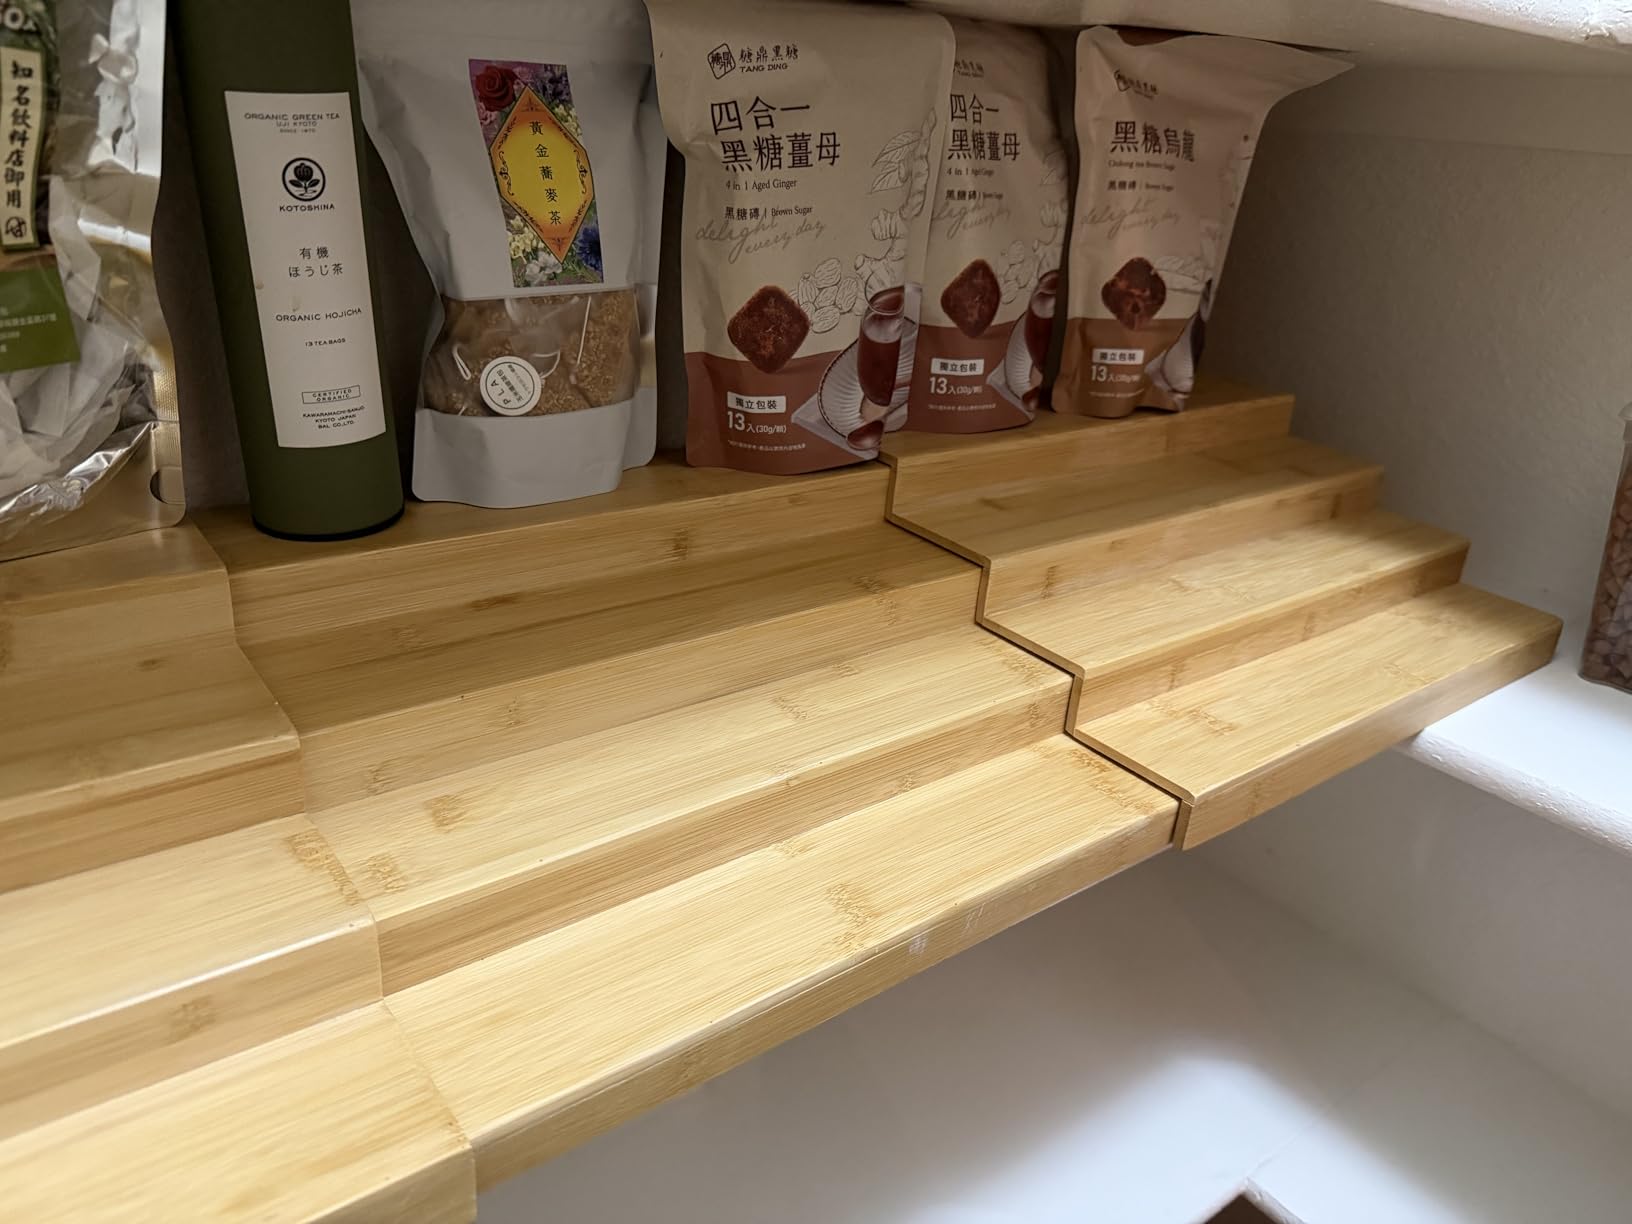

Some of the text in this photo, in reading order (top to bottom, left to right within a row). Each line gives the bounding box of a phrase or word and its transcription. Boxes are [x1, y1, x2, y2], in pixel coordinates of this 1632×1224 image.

[739, 62, 788, 73] TANG DING
[950, 93, 999, 124] 四合一
[244, 112, 340, 121] ORGANIC GREEN TEA
[710, 96, 810, 135] 四合一
[947, 129, 1021, 161] 黑糖薑母
[1109, 120, 1196, 162] 黑糖烏龍
[720, 131, 841, 173] 黑糖薑母
[529, 120, 562, 225] 黃金蕎麥茶
[725, 181, 731, 190] 4
[732, 181, 741, 191] in
[752, 180, 771, 192] Aged
[772, 178, 798, 190] Ginger
[279, 203, 336, 212] KOTOSHINA
[771, 206, 813, 217] Brown Sugar
[299, 247, 329, 260] 有機
[288, 264, 343, 278] ほうじ茶
[275, 307, 362, 322] ORGANIC HOJICHA
[312, 388, 352, 398] CERTIFIED
[316, 393, 350, 402] ORGANIC
[736, 397, 777, 409] 獨立包裝
[315, 413, 357, 424] KYOTO JAPAN
